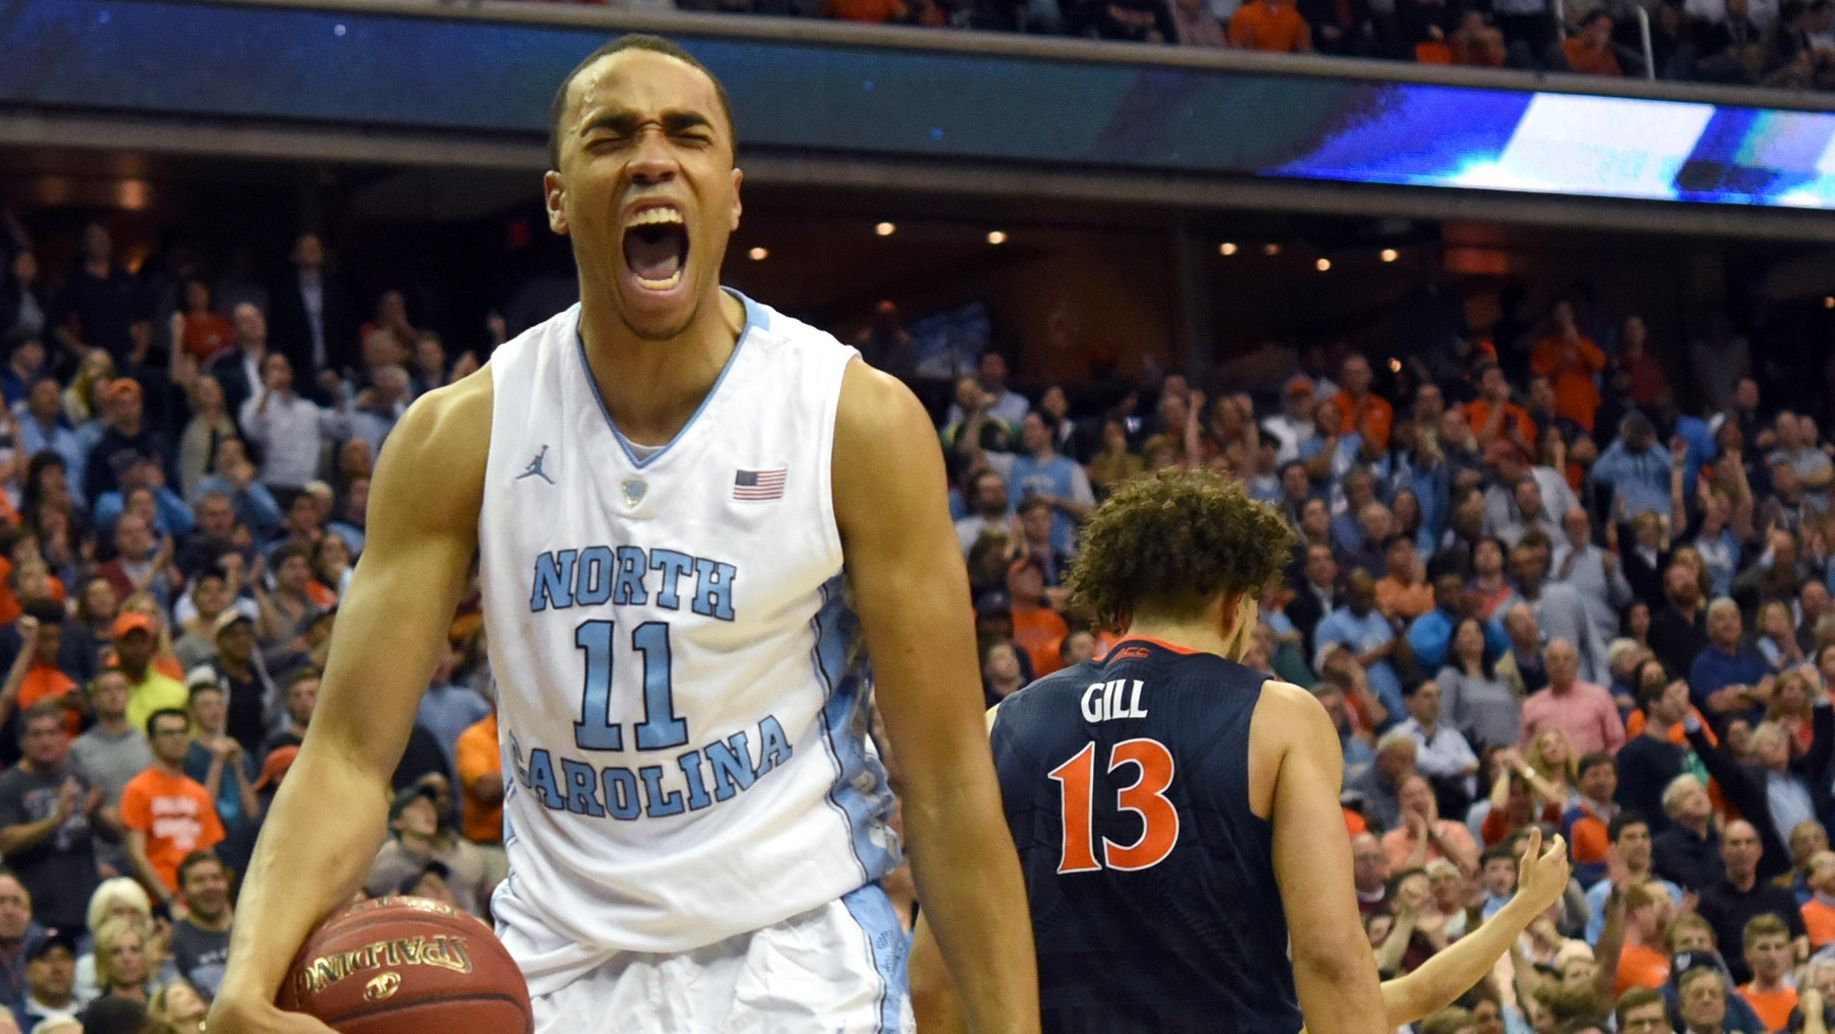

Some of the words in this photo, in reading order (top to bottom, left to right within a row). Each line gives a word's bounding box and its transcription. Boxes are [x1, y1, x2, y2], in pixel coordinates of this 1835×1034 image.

[530, 545, 737, 622] NORTH
[573, 619, 689, 752] 11
[1081, 678, 1148, 723] GILL
[1047, 737, 1180, 875] 13
